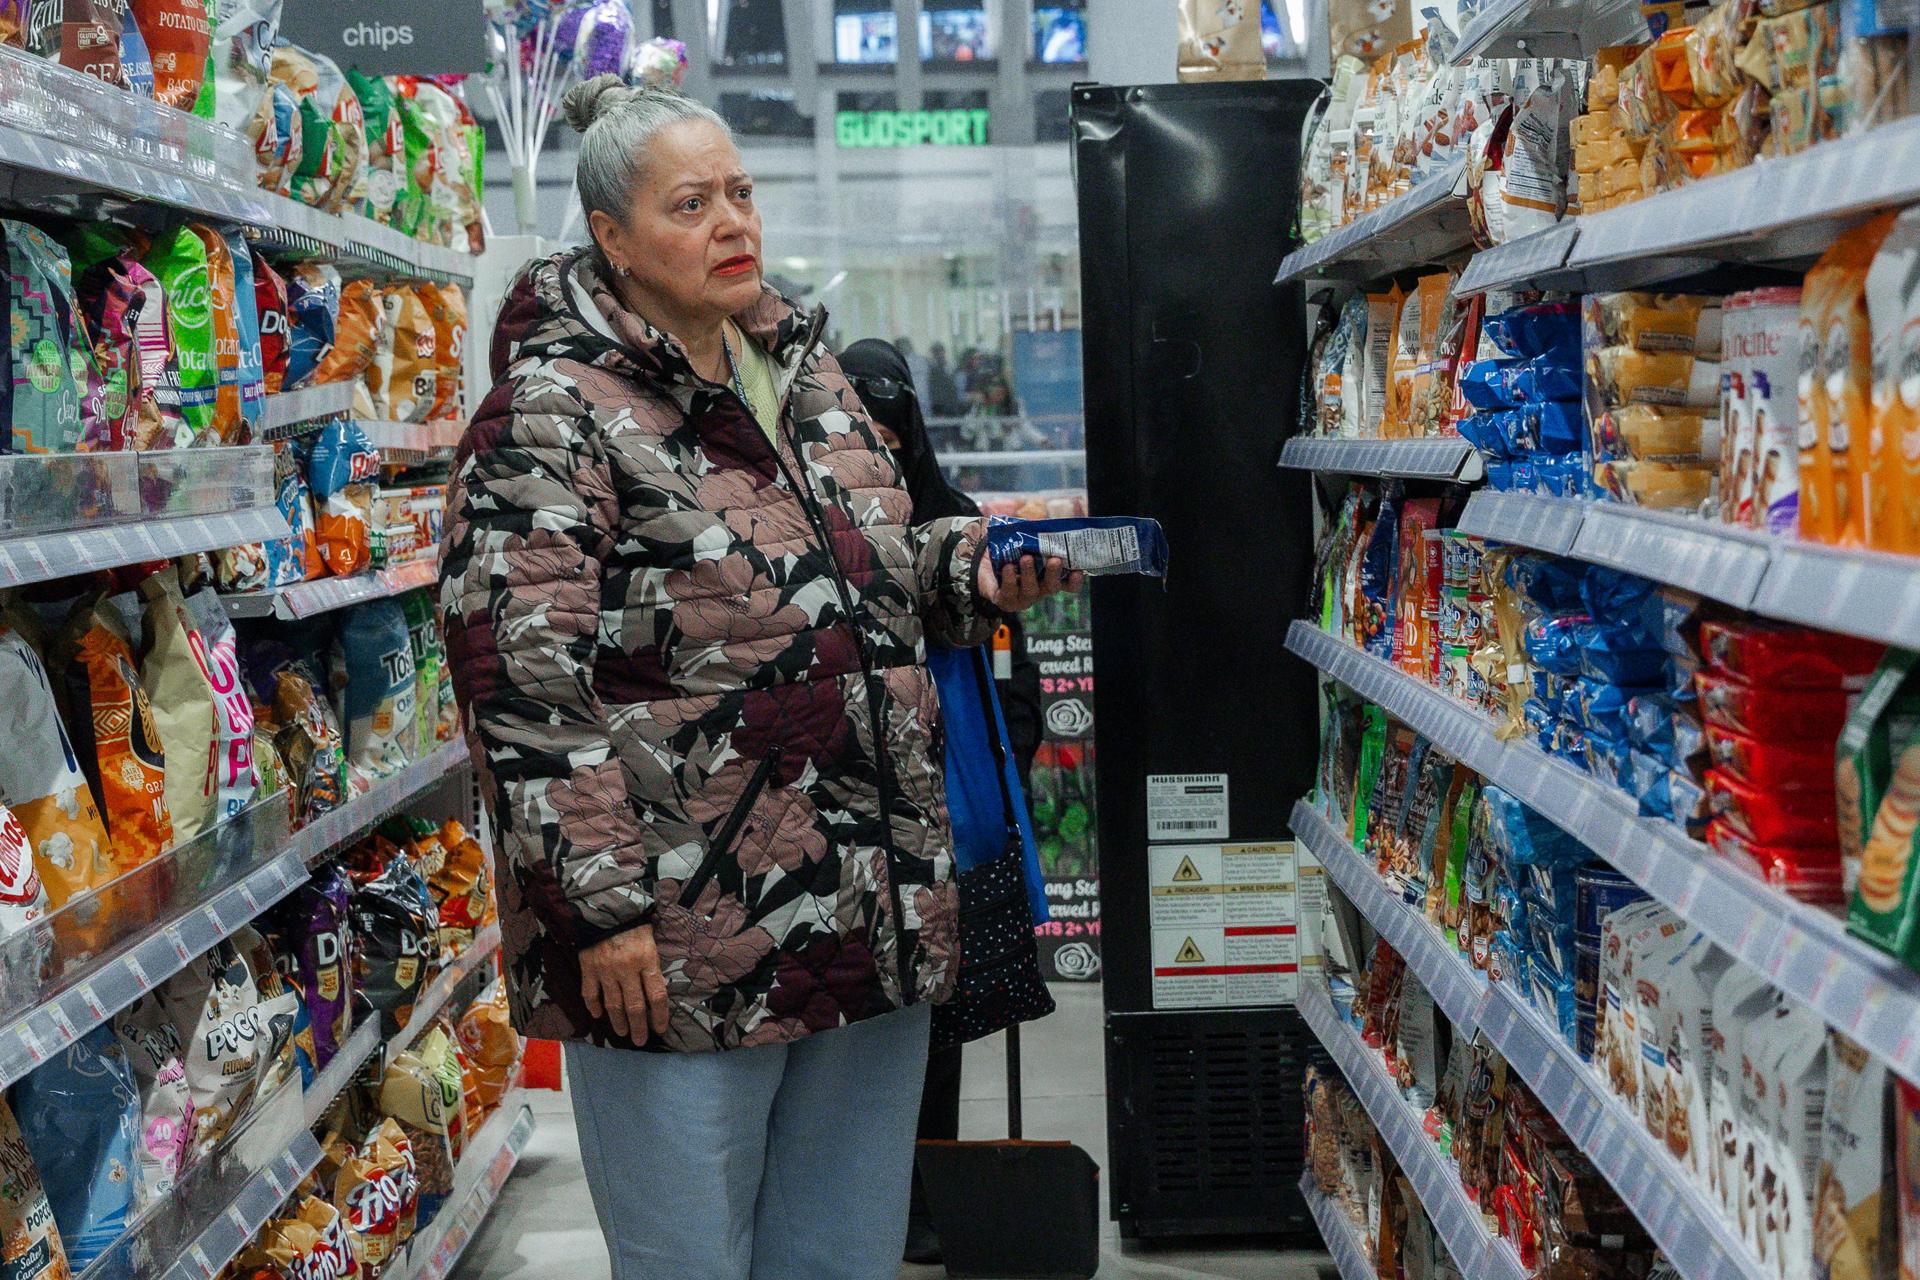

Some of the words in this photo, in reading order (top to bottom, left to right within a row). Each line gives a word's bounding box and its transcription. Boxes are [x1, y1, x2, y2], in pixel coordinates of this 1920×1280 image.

[160, 11, 196, 31] POTATO
[343, 22, 413, 51] chips
[1026, 636, 1064, 657] Long
[1039, 656, 1081, 675] erved
[1048, 900, 1091, 918] erved
[154, 1125, 171, 1141] 40
